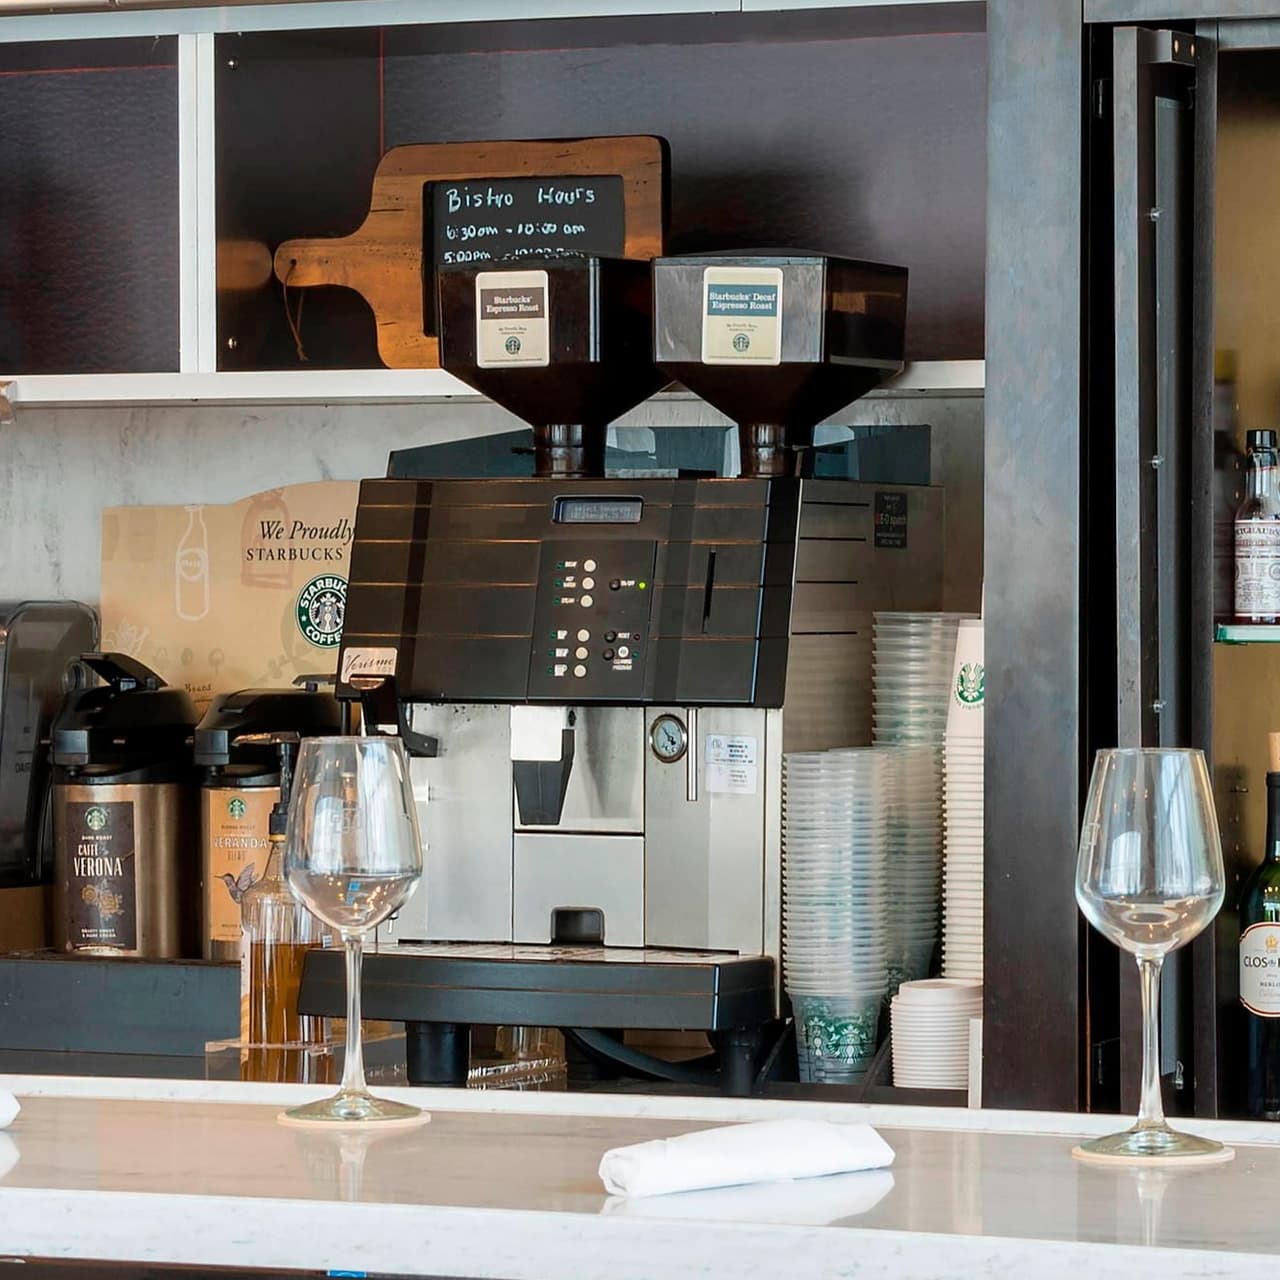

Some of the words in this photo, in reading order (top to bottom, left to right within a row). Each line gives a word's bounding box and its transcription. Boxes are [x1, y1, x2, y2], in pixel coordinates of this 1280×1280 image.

[446, 187, 513, 213] Bistro
[538, 187, 595, 205] Hours
[753, 293, 776, 301] Decaf
[260, 520, 283, 540] We
[290, 519, 356, 545] Proudly
[246, 547, 343, 561] STARBUCKS
[300, 578, 349, 608] STARBUC
[305, 625, 344, 645] COFFE
[74, 857, 123, 877] VERONA
[1244, 955, 1268, 968] CLOS
